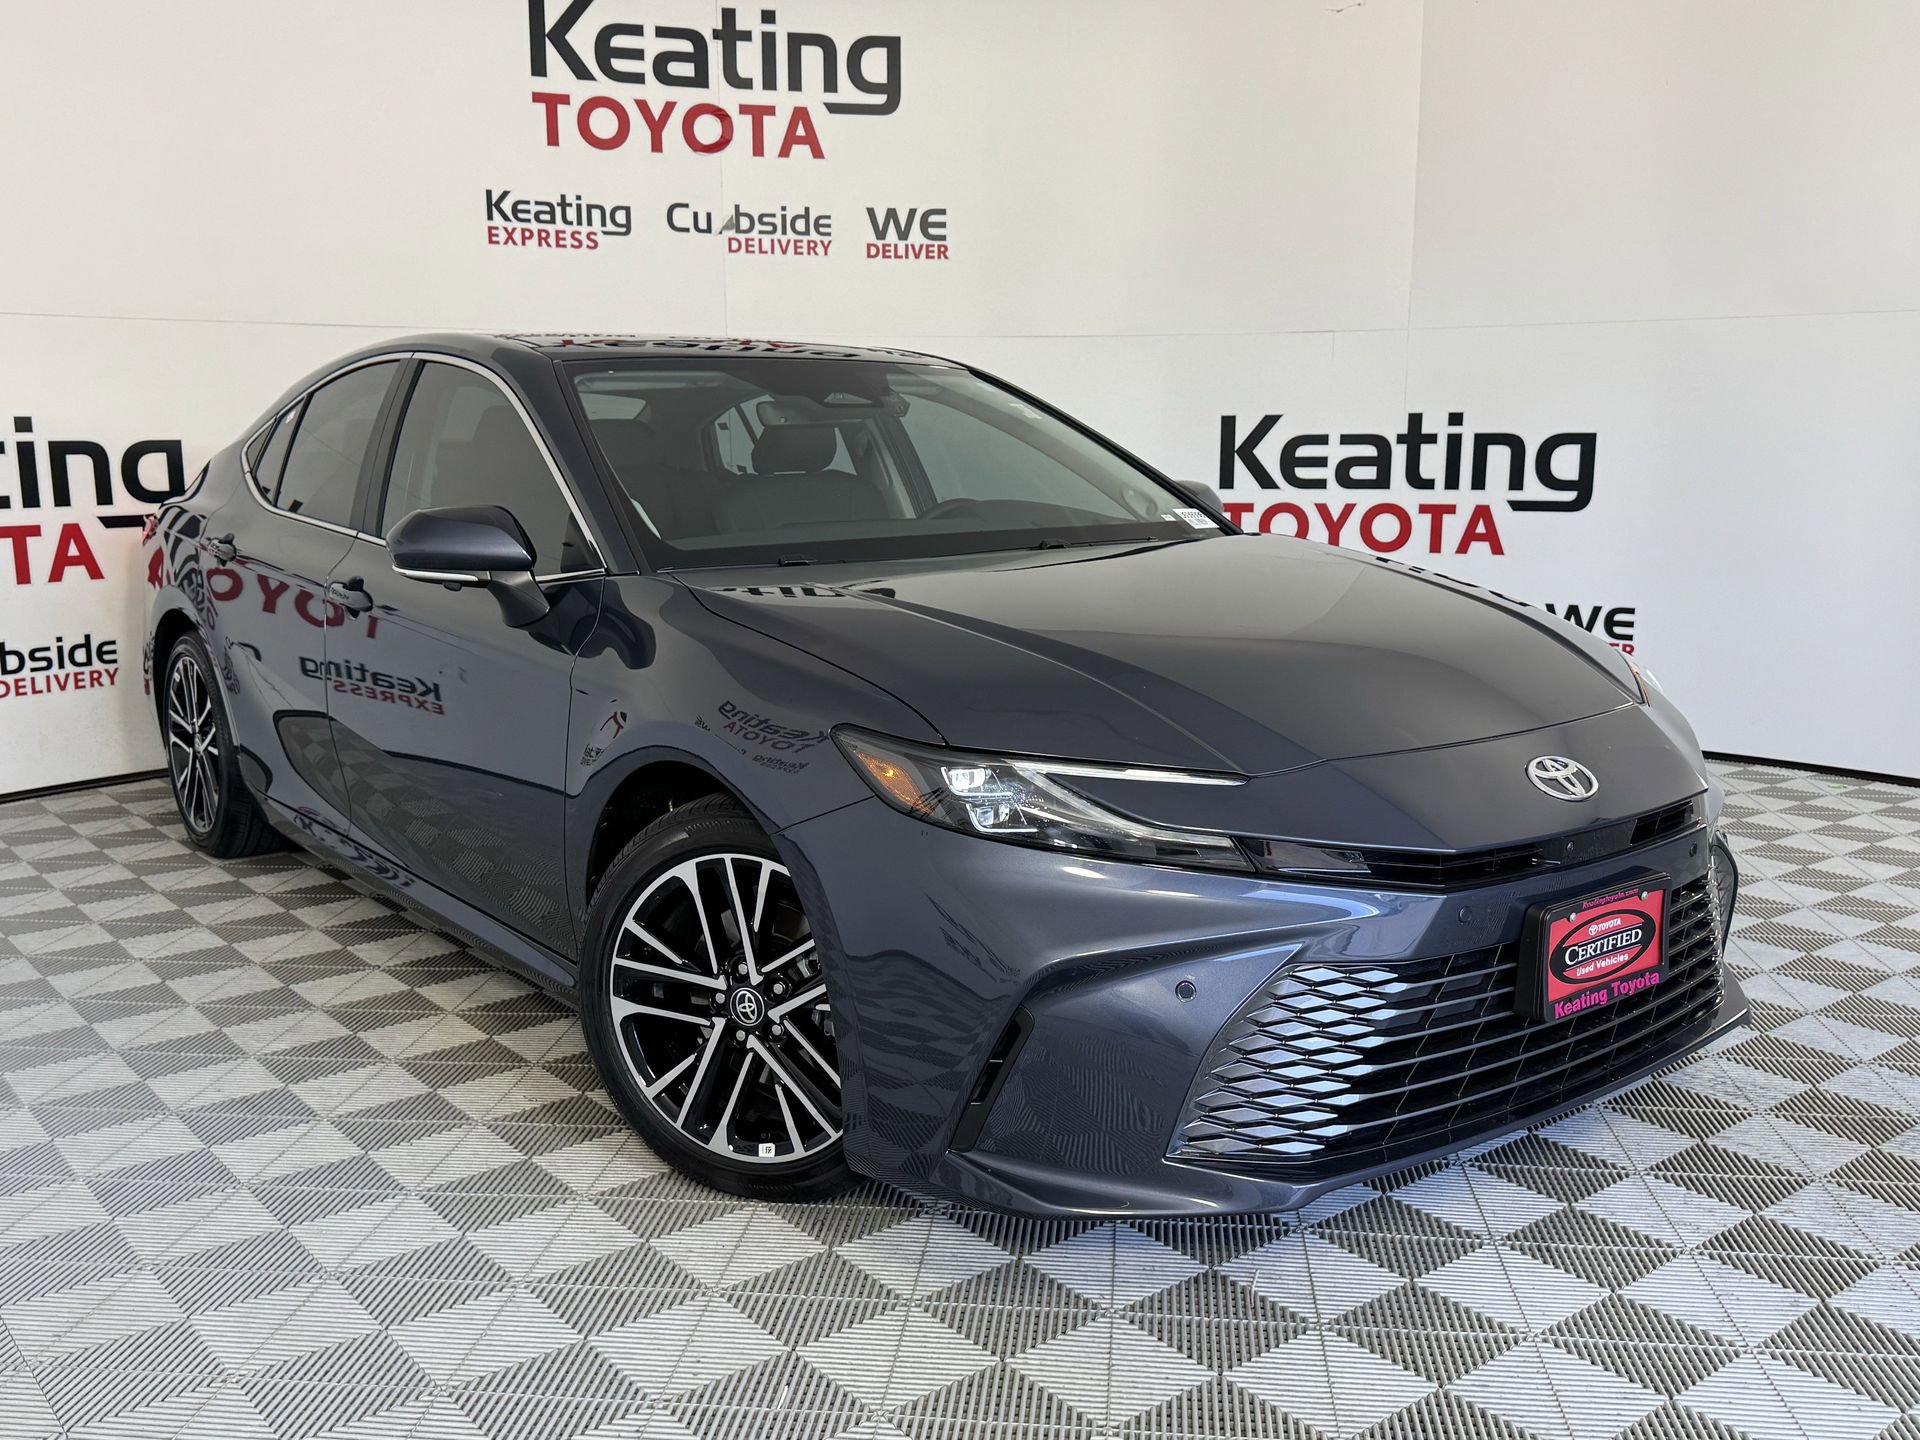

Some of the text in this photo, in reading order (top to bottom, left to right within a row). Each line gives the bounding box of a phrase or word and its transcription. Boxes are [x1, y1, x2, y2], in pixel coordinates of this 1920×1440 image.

[527, 0, 902, 116] Keating
[532, 91, 826, 160] TOYOTA
[485, 189, 632, 237] Keating
[666, 202, 832, 237] Cubside
[866, 207, 947, 242] WE
[487, 226, 600, 250] EXPRESS
[727, 237, 832, 257] DELIVERY
[866, 243, 950, 260] DELIVER
[0, 416, 186, 529] ing
[1218, 412, 1597, 512] Keating
[1222, 502, 1505, 556] TOYOTA
[1598, 917, 1621, 932] TOYOTA
[1564, 928, 1642, 966] CERTIFIED
[1576, 952, 1629, 977] Used Vehicles
[1554, 970, 1660, 1019] Keating Toyota
